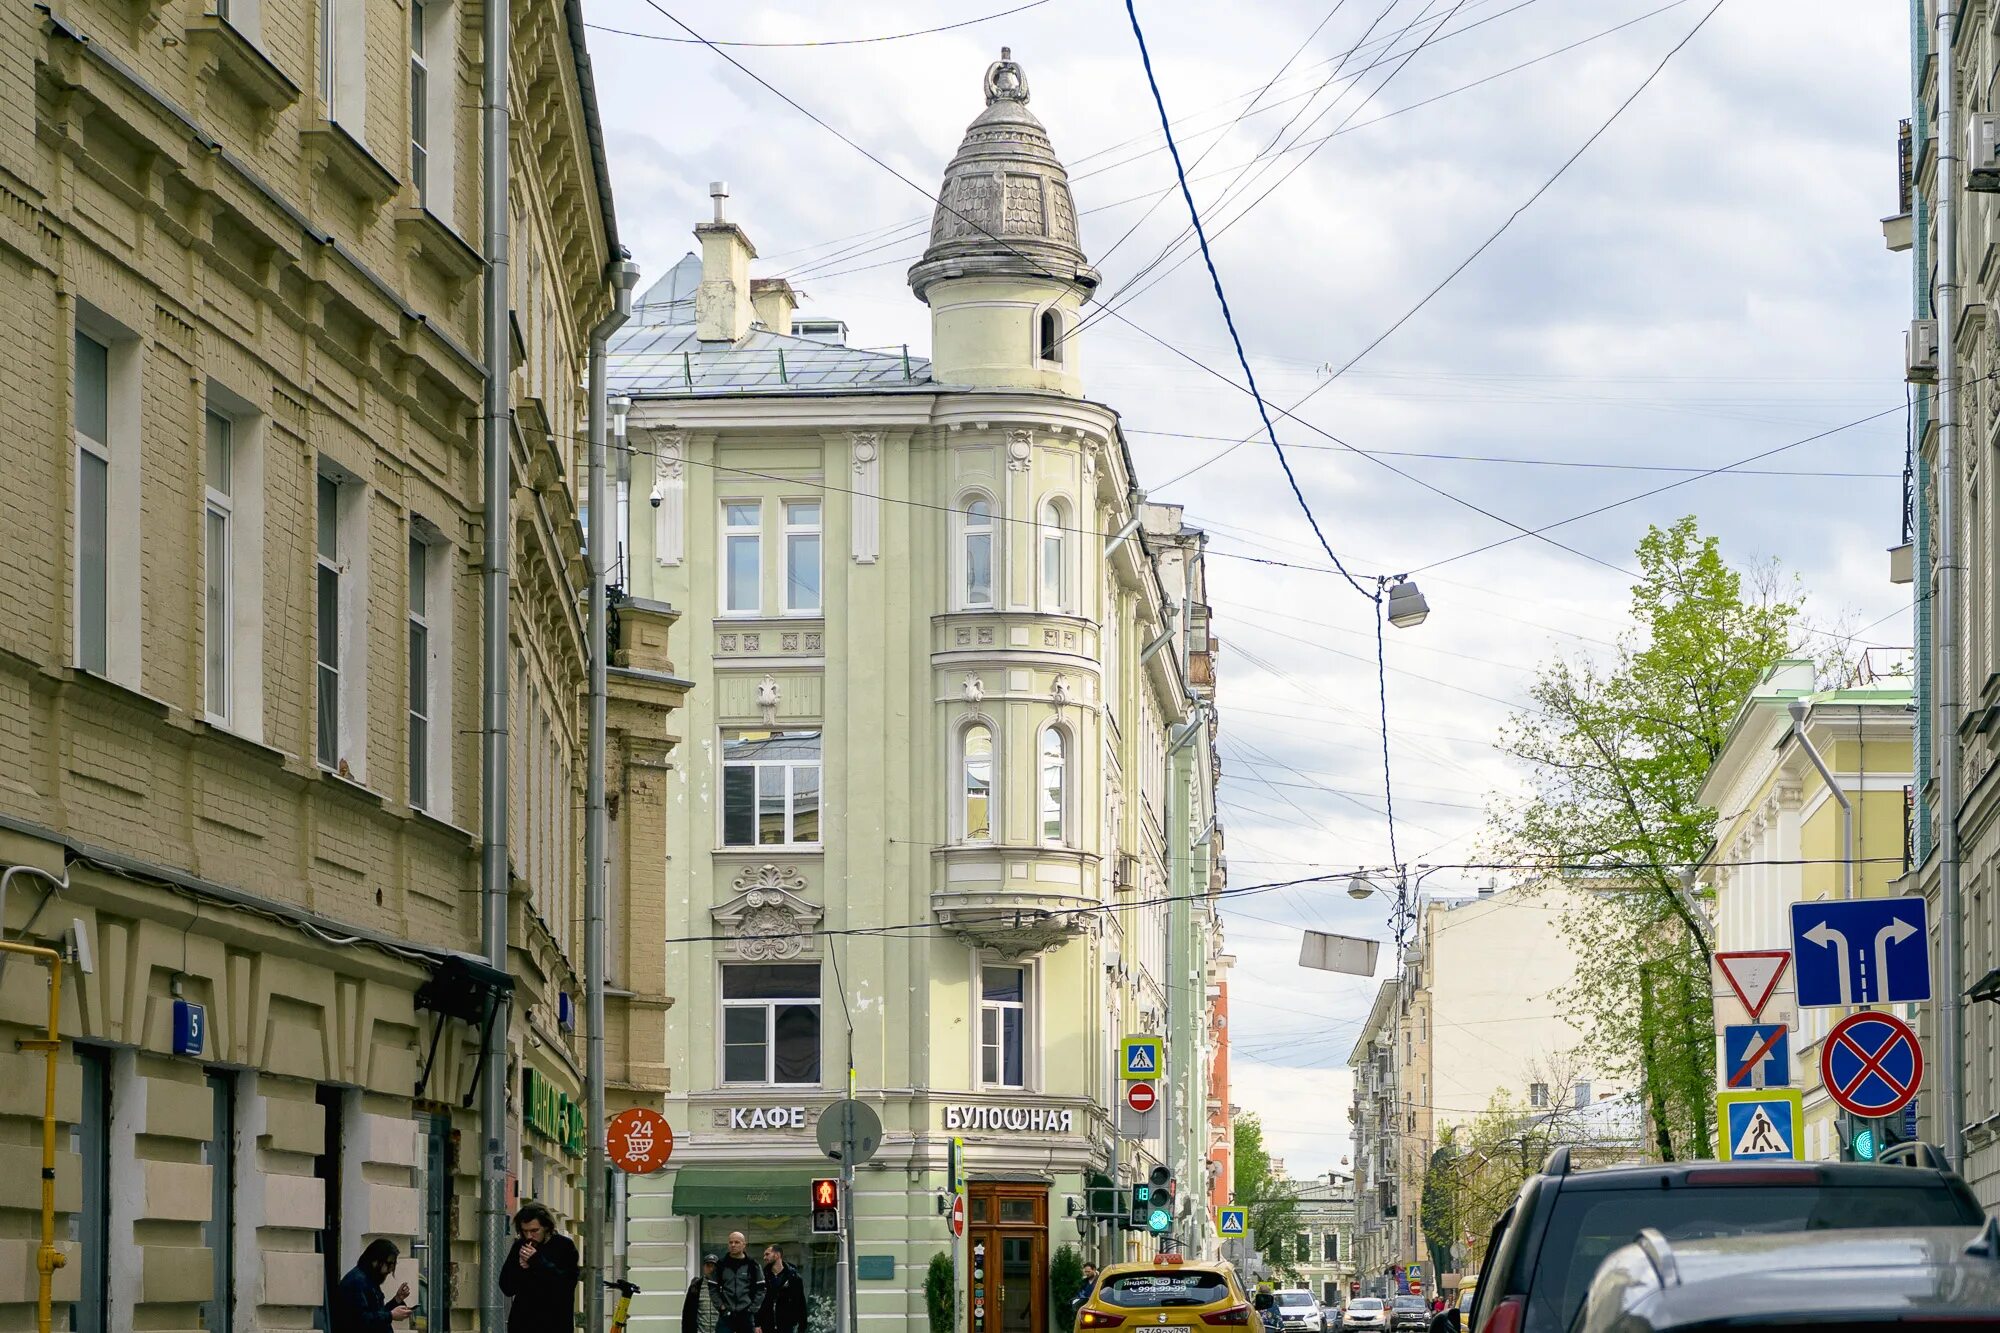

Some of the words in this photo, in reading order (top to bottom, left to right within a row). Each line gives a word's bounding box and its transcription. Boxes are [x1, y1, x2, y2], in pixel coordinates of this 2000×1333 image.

[191, 1013, 199, 1038] 5
[630, 1120, 654, 1138] 24
[730, 1106, 805, 1129] КАФЕ
